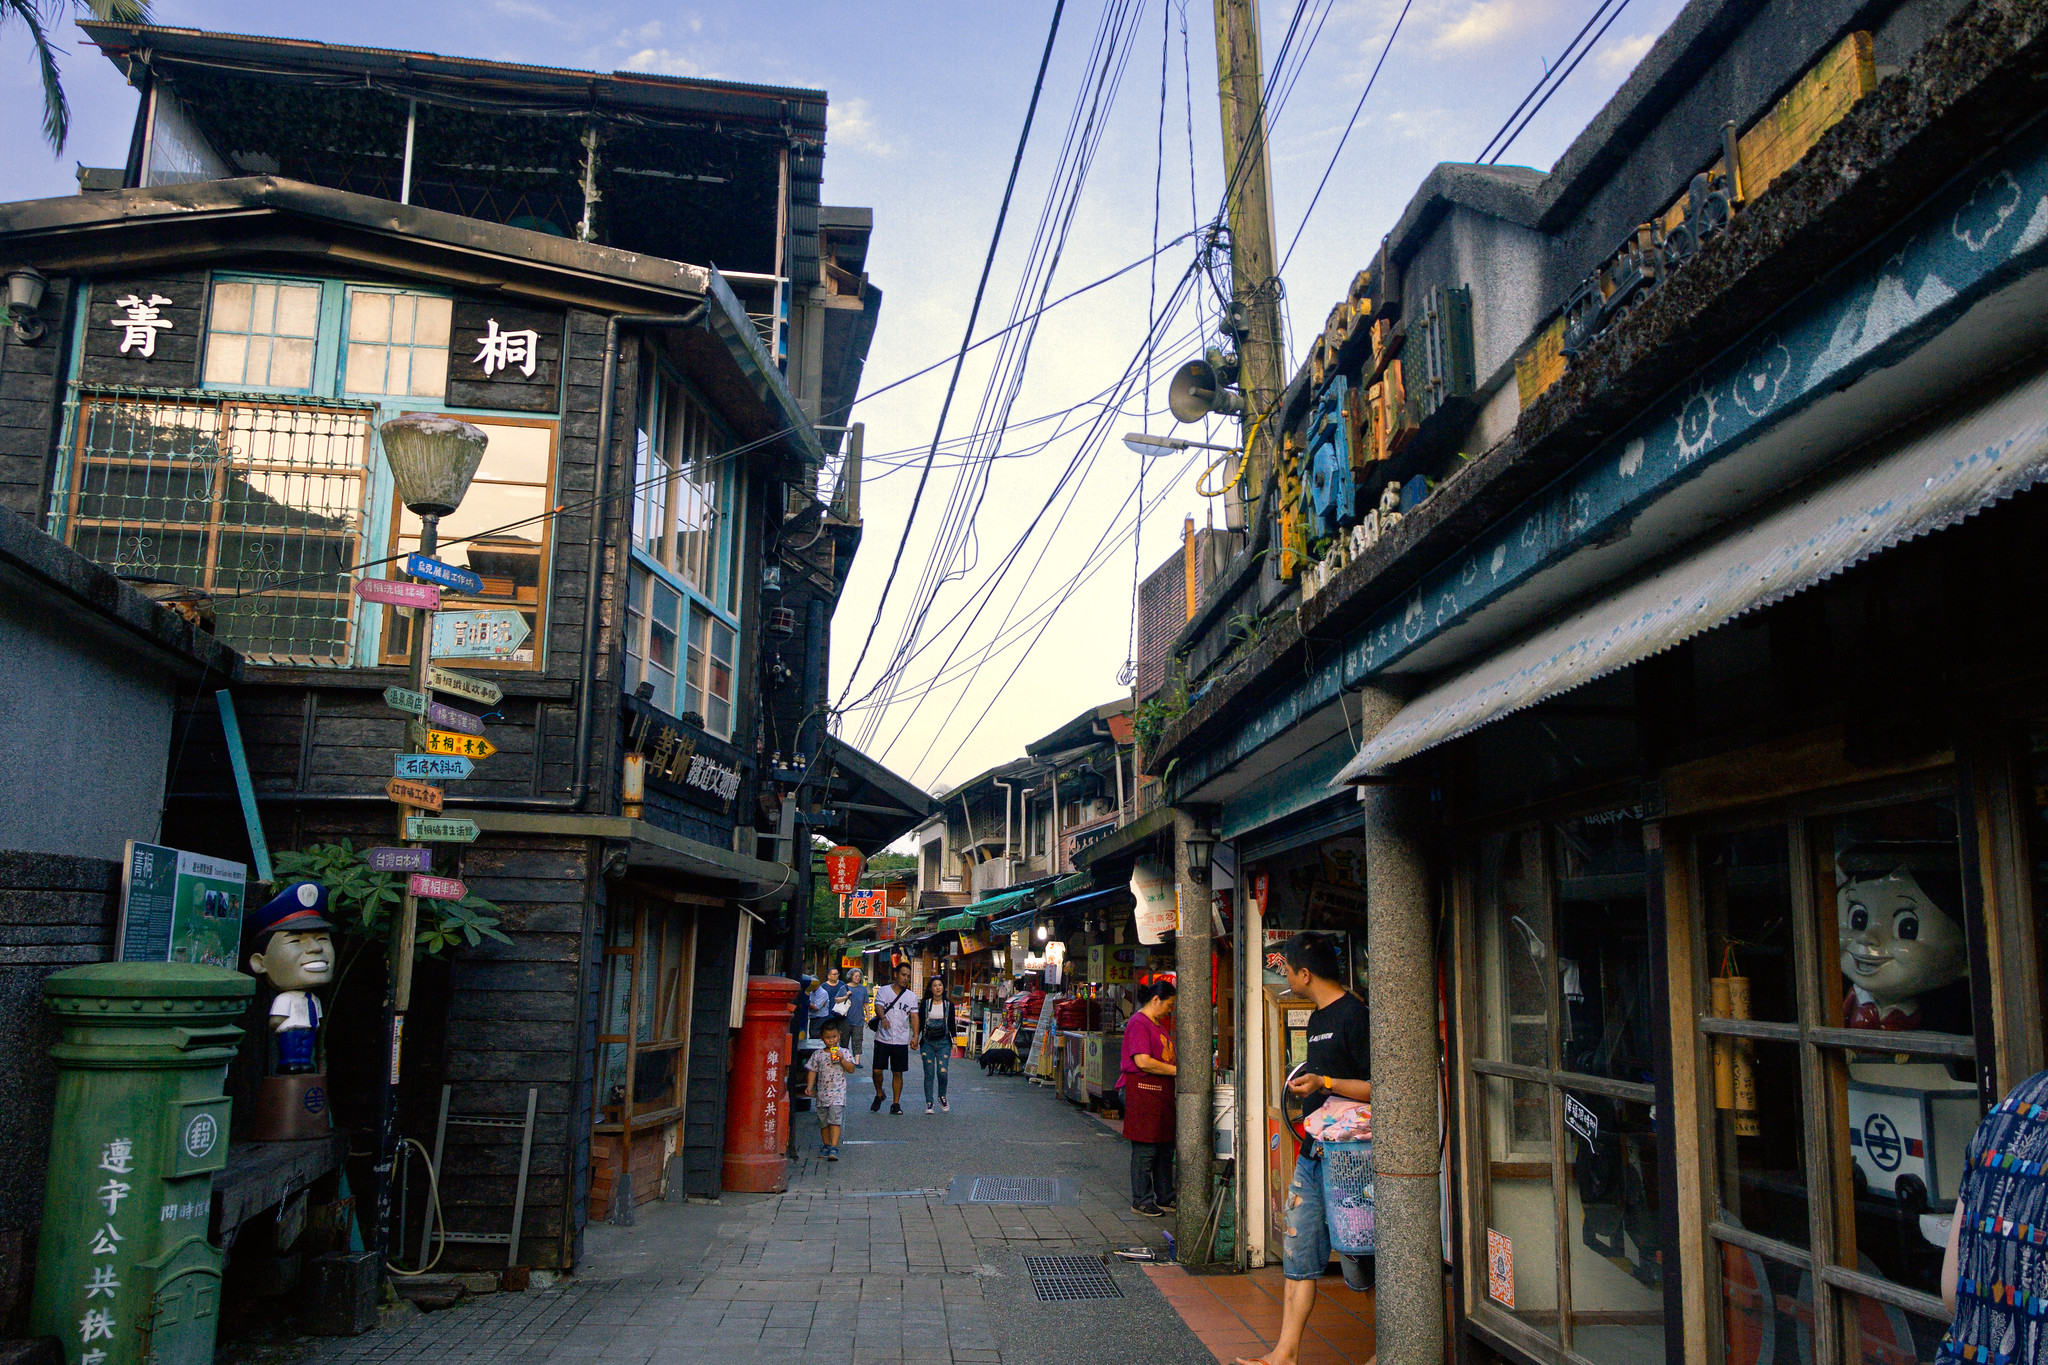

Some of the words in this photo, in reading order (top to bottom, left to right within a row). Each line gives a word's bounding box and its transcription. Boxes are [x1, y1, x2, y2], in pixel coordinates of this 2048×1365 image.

[111, 294, 173, 358] 菁
[472, 318, 539, 379] 桐
[418, 560, 474, 587] 烏克麗麗工作坊
[453, 621, 512, 648] 菁桐坑
[434, 673, 497, 700] 菁桐鐵道故事館
[429, 733, 454, 752] 菁桐
[464, 739, 489, 756] 素食
[406, 758, 464, 774] 石底大斜坑
[133, 849, 154, 879] 菁桐
[420, 878, 460, 896] 菁桐車站
[1149, 924, 1174, 933] Yakult
[763, 1050, 779, 1151] 維護公共道德
